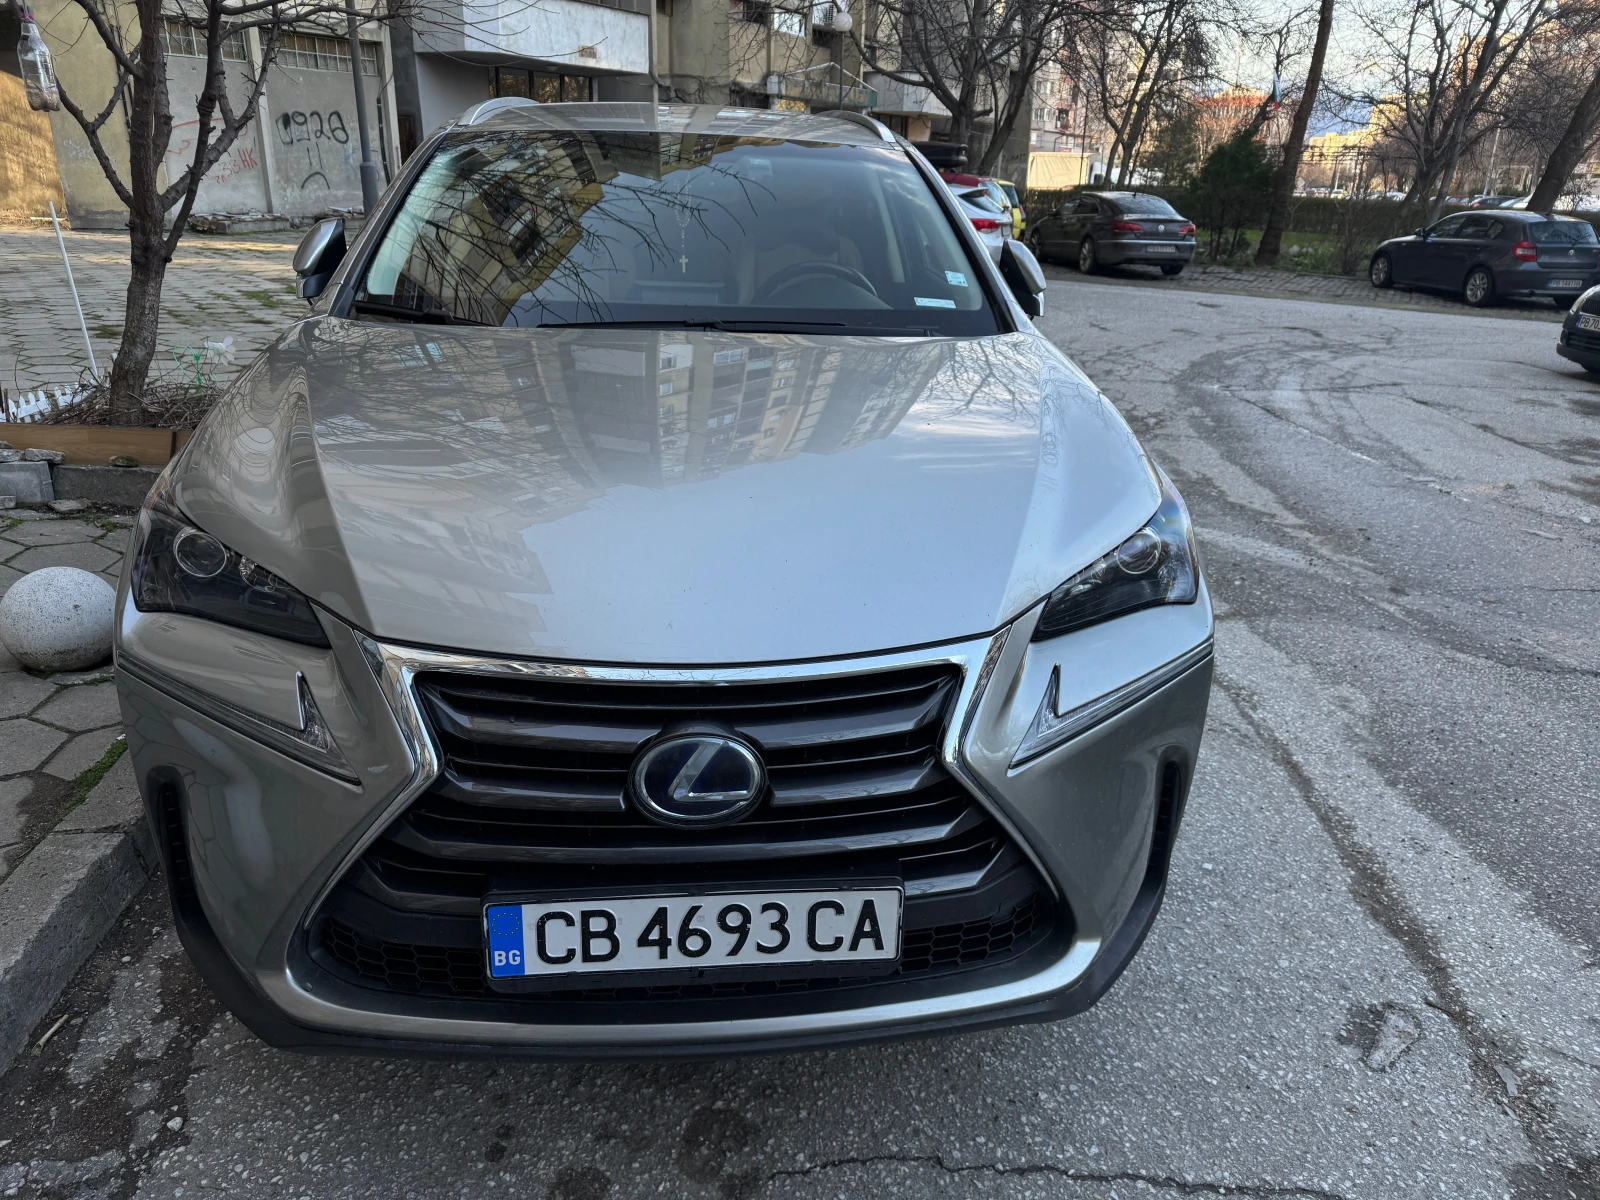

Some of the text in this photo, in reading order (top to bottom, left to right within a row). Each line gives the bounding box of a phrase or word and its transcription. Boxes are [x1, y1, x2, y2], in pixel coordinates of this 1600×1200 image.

[1580, 316, 1600, 330] PB 70
[536, 898, 885, 965] CB 4693 CA
[494, 950, 521, 966] BG
